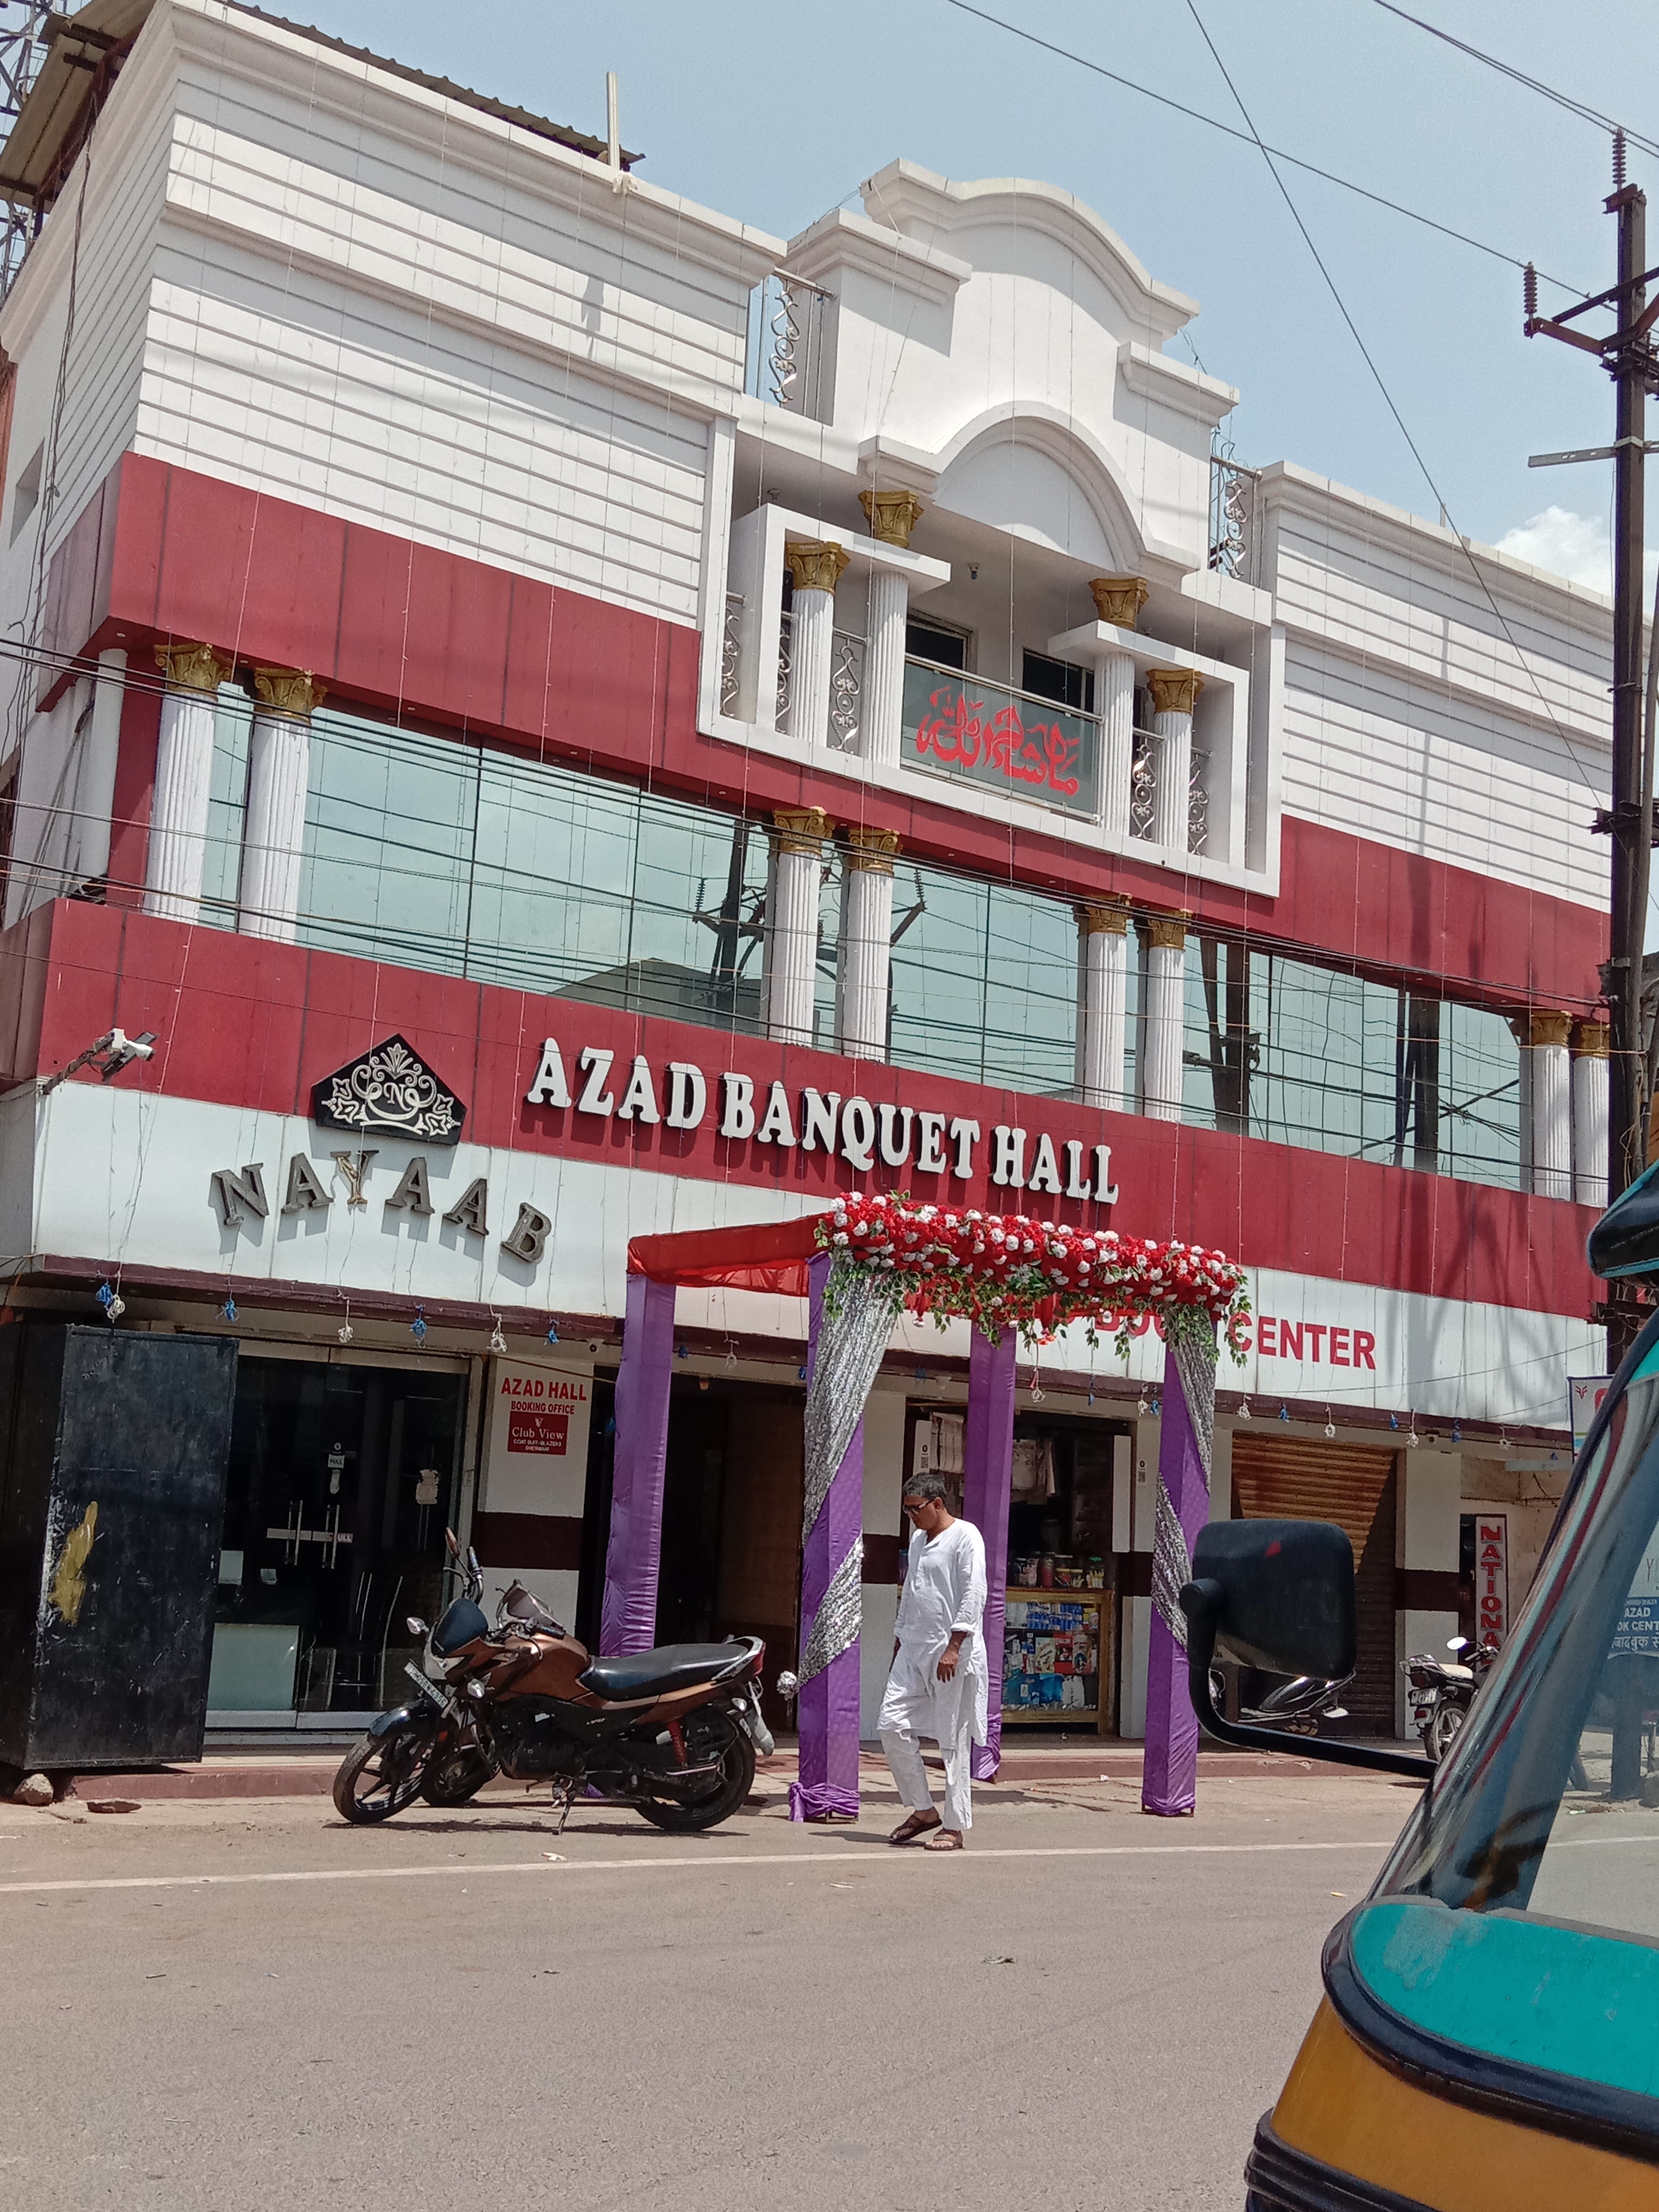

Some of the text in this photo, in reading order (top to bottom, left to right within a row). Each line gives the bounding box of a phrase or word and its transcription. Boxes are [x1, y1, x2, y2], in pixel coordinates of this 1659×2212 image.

[527, 1037, 1119, 1205] AZAD BANQUET HALL
[212, 1150, 552, 1263] NAYAAB
[1228, 1311, 1376, 1370] CENTER
[501, 1377, 586, 1401] AZAD HALL
[511, 1401, 575, 1415] BOOKING OFFICE
[512, 1427, 565, 1440] Club View
[1623, 1607, 1651, 1618] AZAD
[1631, 1620, 1659, 1631] CENT
